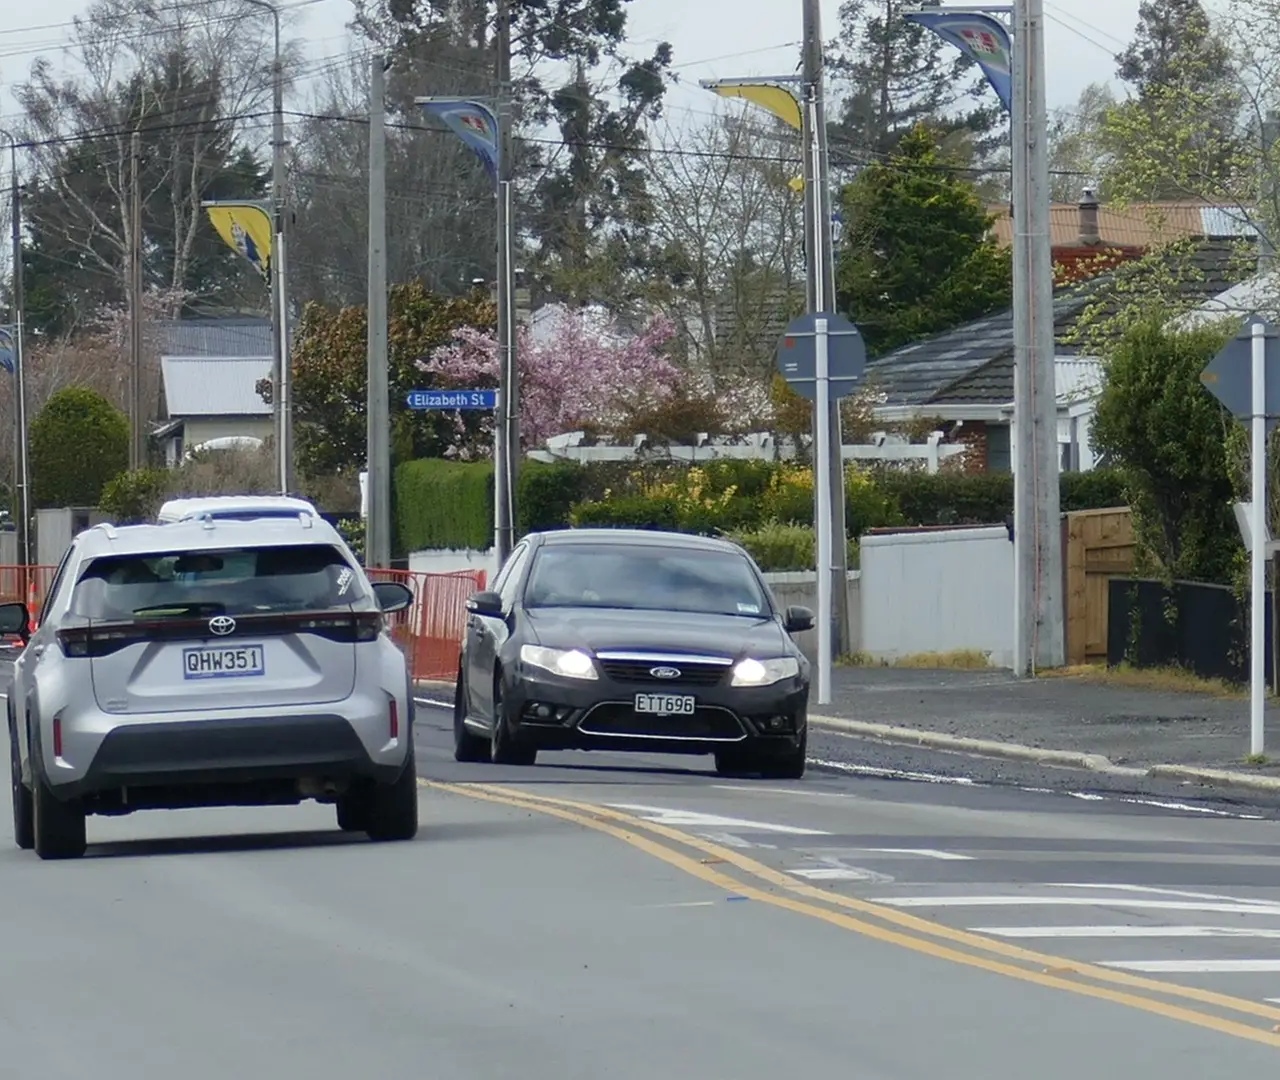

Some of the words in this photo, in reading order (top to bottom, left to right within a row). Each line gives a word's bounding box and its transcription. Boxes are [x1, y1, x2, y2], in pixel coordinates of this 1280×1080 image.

[414, 393, 468, 406] Elizabeth
[471, 392, 485, 406] St
[187, 649, 258, 672] QHW351
[637, 696, 693, 712] ETT696
